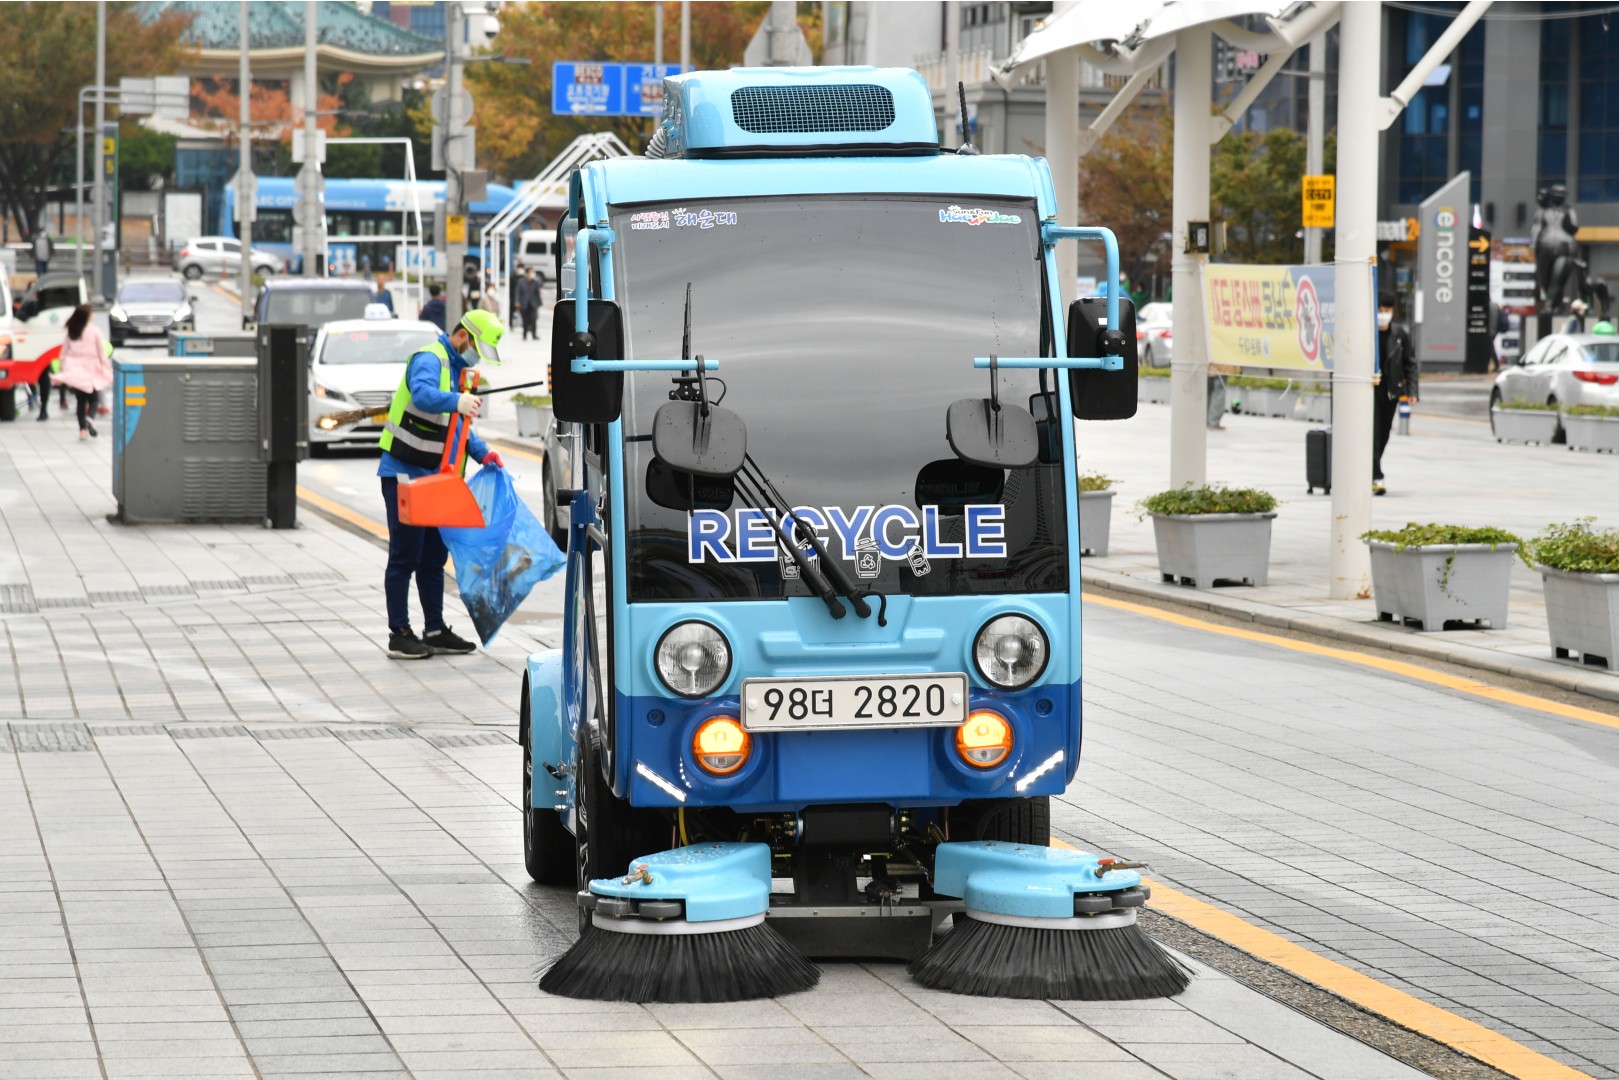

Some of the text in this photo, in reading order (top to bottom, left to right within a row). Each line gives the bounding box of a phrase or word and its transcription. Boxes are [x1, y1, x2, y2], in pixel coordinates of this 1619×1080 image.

[674, 209, 738, 230] 해운대
[1435, 209, 1456, 304] encore
[687, 503, 1008, 564] RECYCLE
[763, 684, 946, 721] 98더 2820
